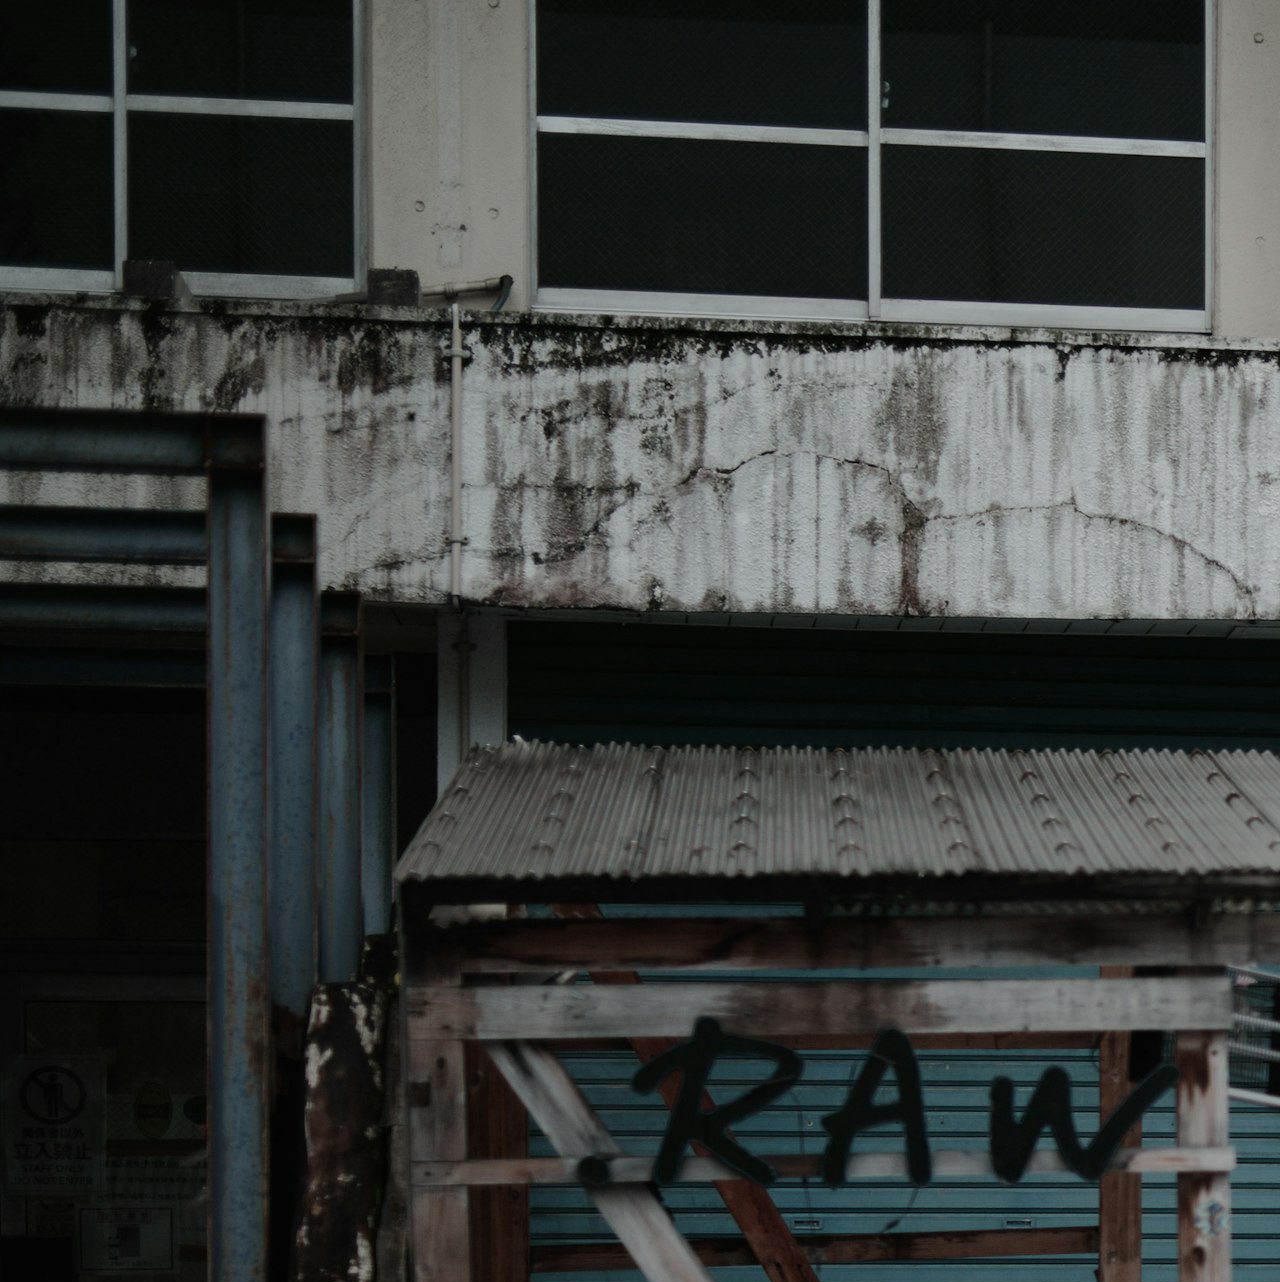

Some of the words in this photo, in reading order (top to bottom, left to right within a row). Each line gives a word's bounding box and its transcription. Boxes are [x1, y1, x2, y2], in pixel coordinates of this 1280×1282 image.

[14, 1142, 92, 1159] 立入禁止
[22, 1164, 53, 1173] STAFF
[55, 1165, 84, 1173] ONLY
[33, 1176, 56, 1185] NOT
